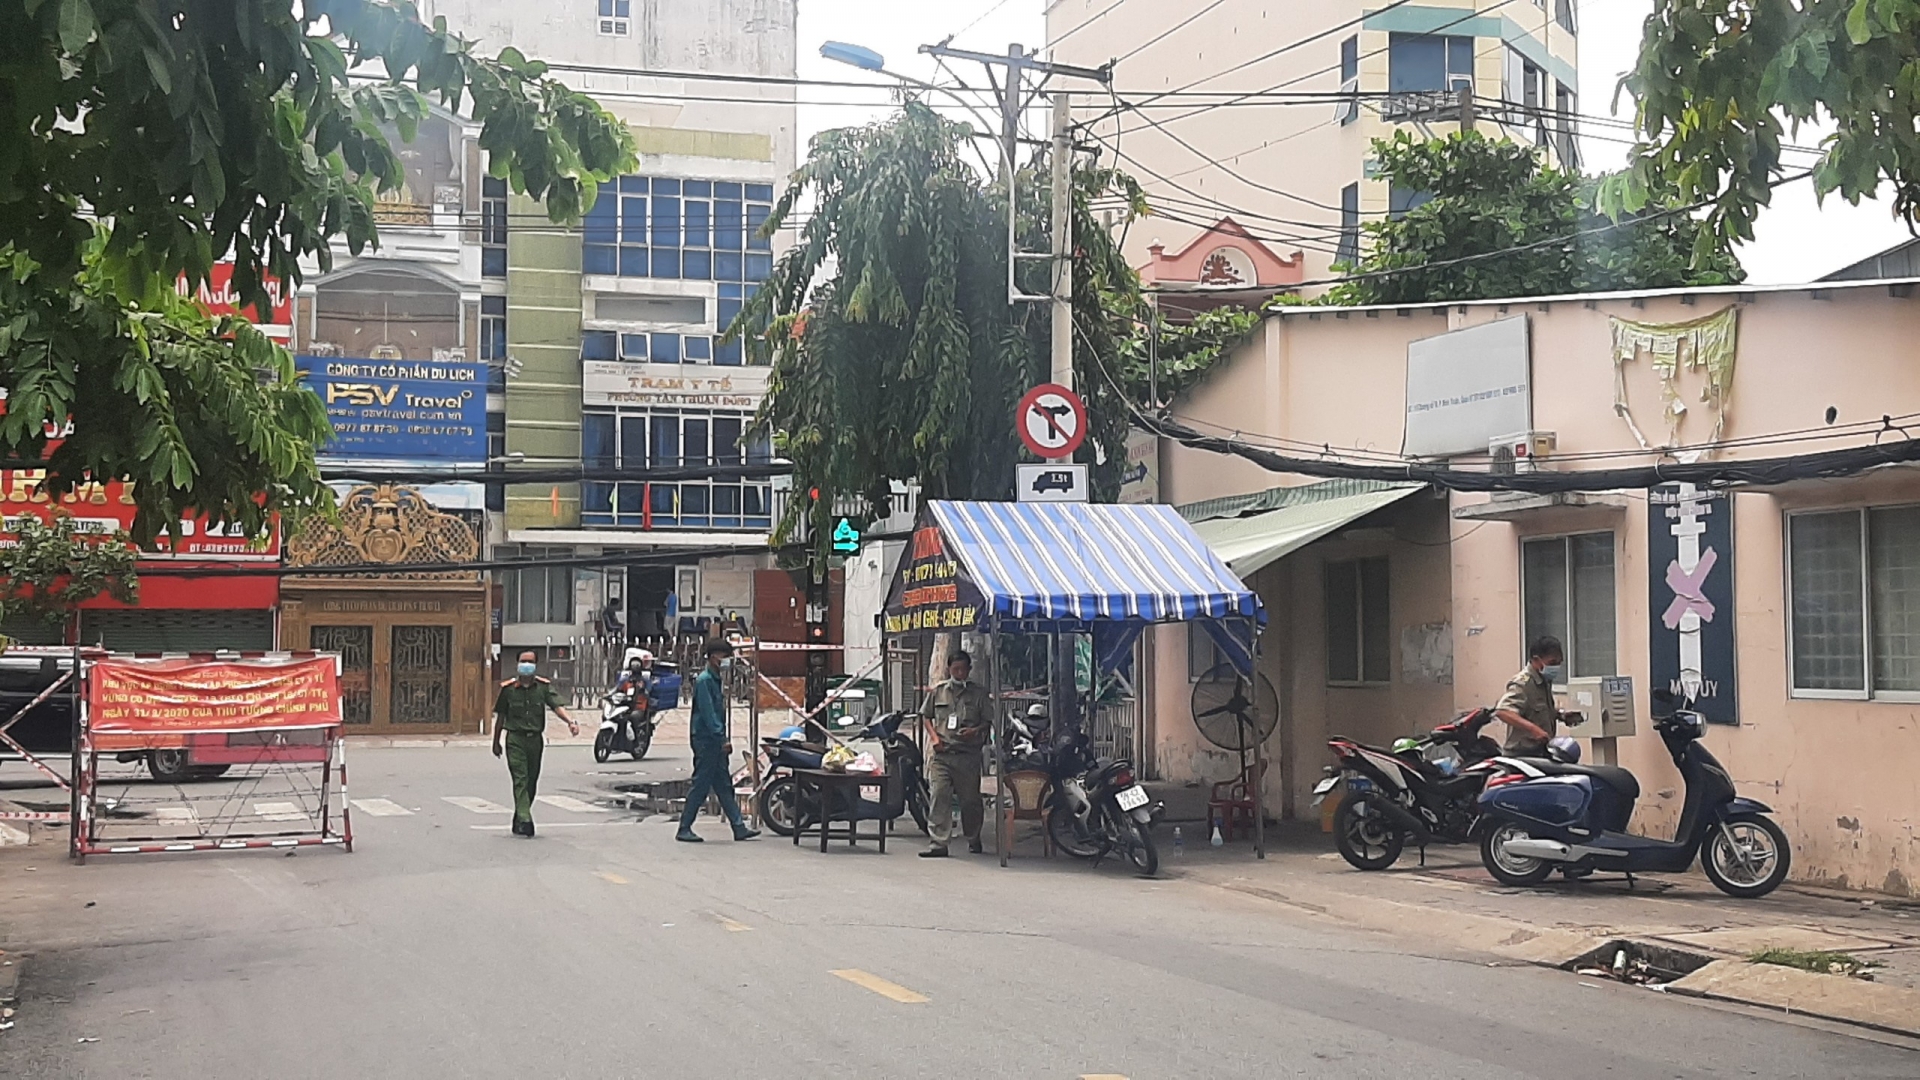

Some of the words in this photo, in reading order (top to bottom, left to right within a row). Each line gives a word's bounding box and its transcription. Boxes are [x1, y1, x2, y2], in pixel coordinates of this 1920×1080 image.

[431, 368, 447, 380] DU
[690, 379, 703, 390] Y
[327, 382, 400, 405] PSV
[405, 394, 462, 409] Travel
